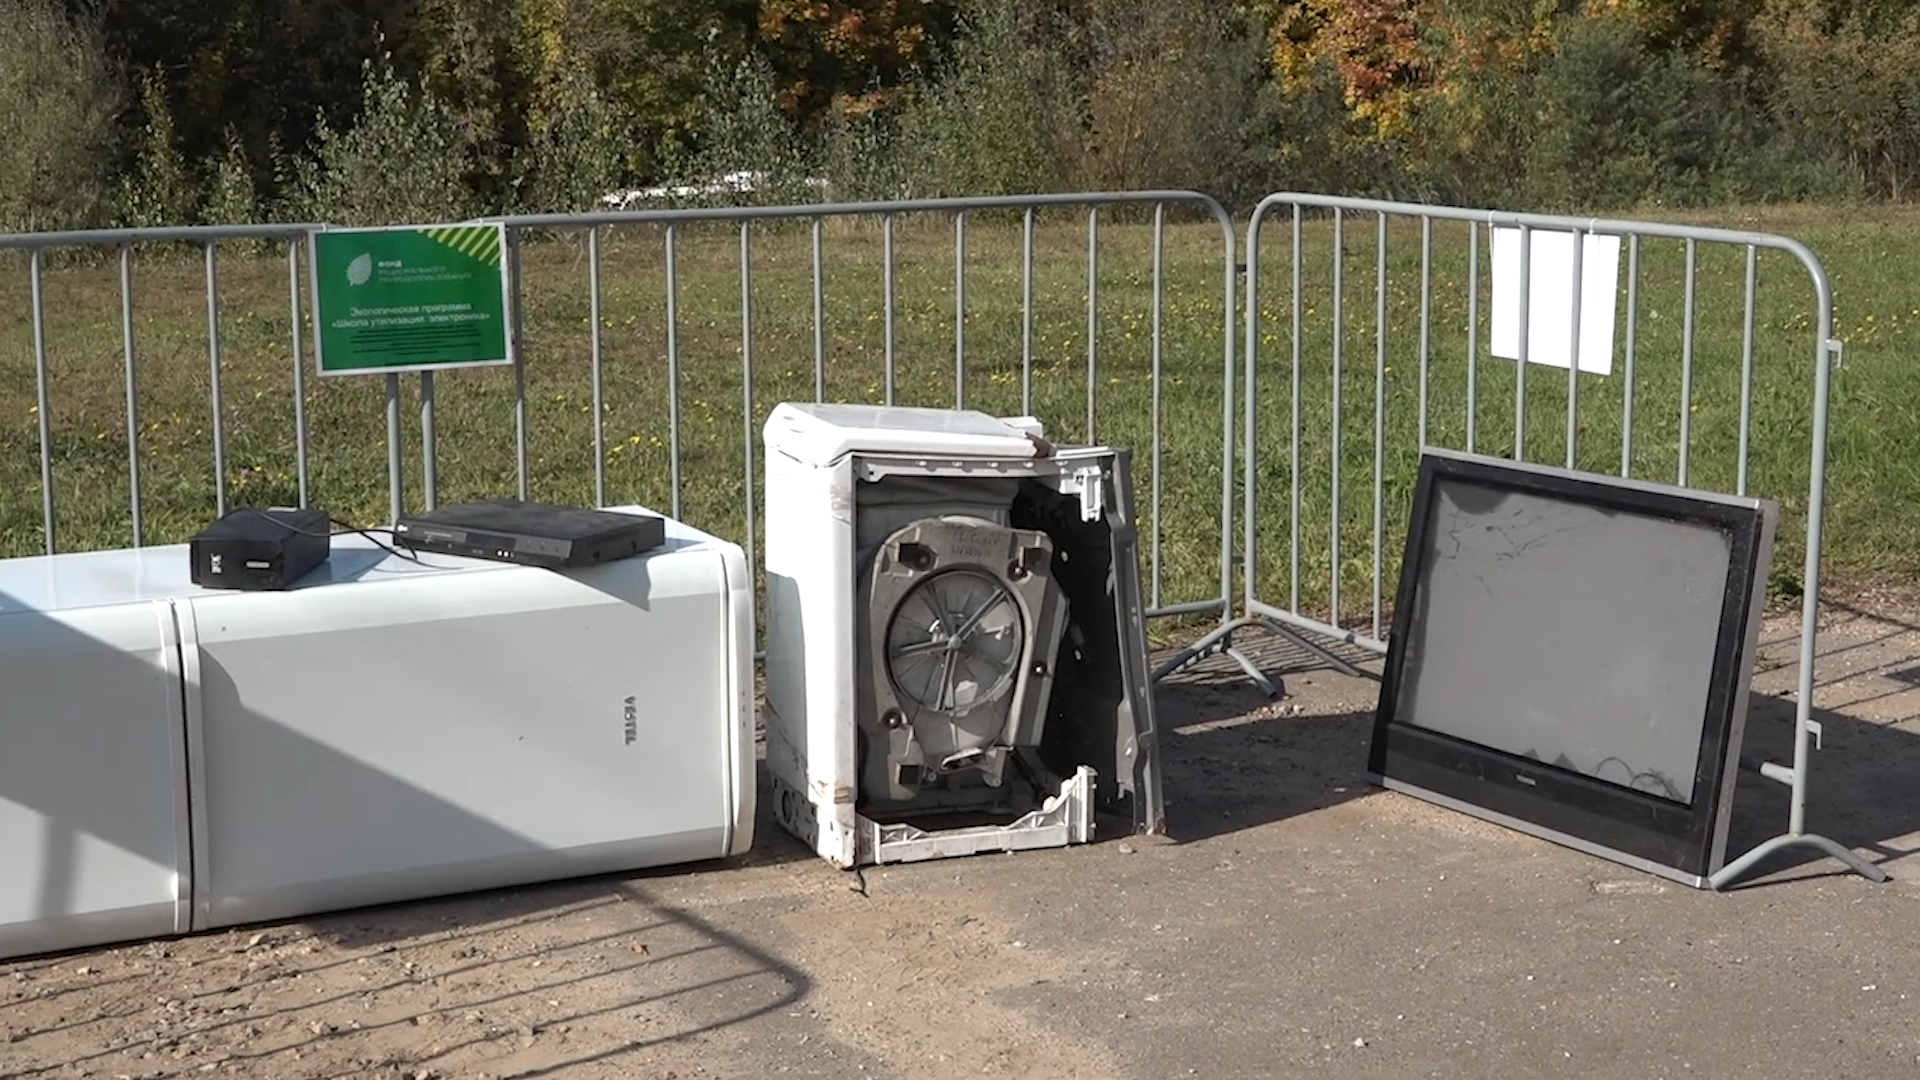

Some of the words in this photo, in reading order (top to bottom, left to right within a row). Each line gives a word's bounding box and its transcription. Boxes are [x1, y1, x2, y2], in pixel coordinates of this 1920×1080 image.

[350, 306, 420, 317] Экологическая
[421, 303, 472, 313] программа
[624, 696, 637, 746] VESTEL
